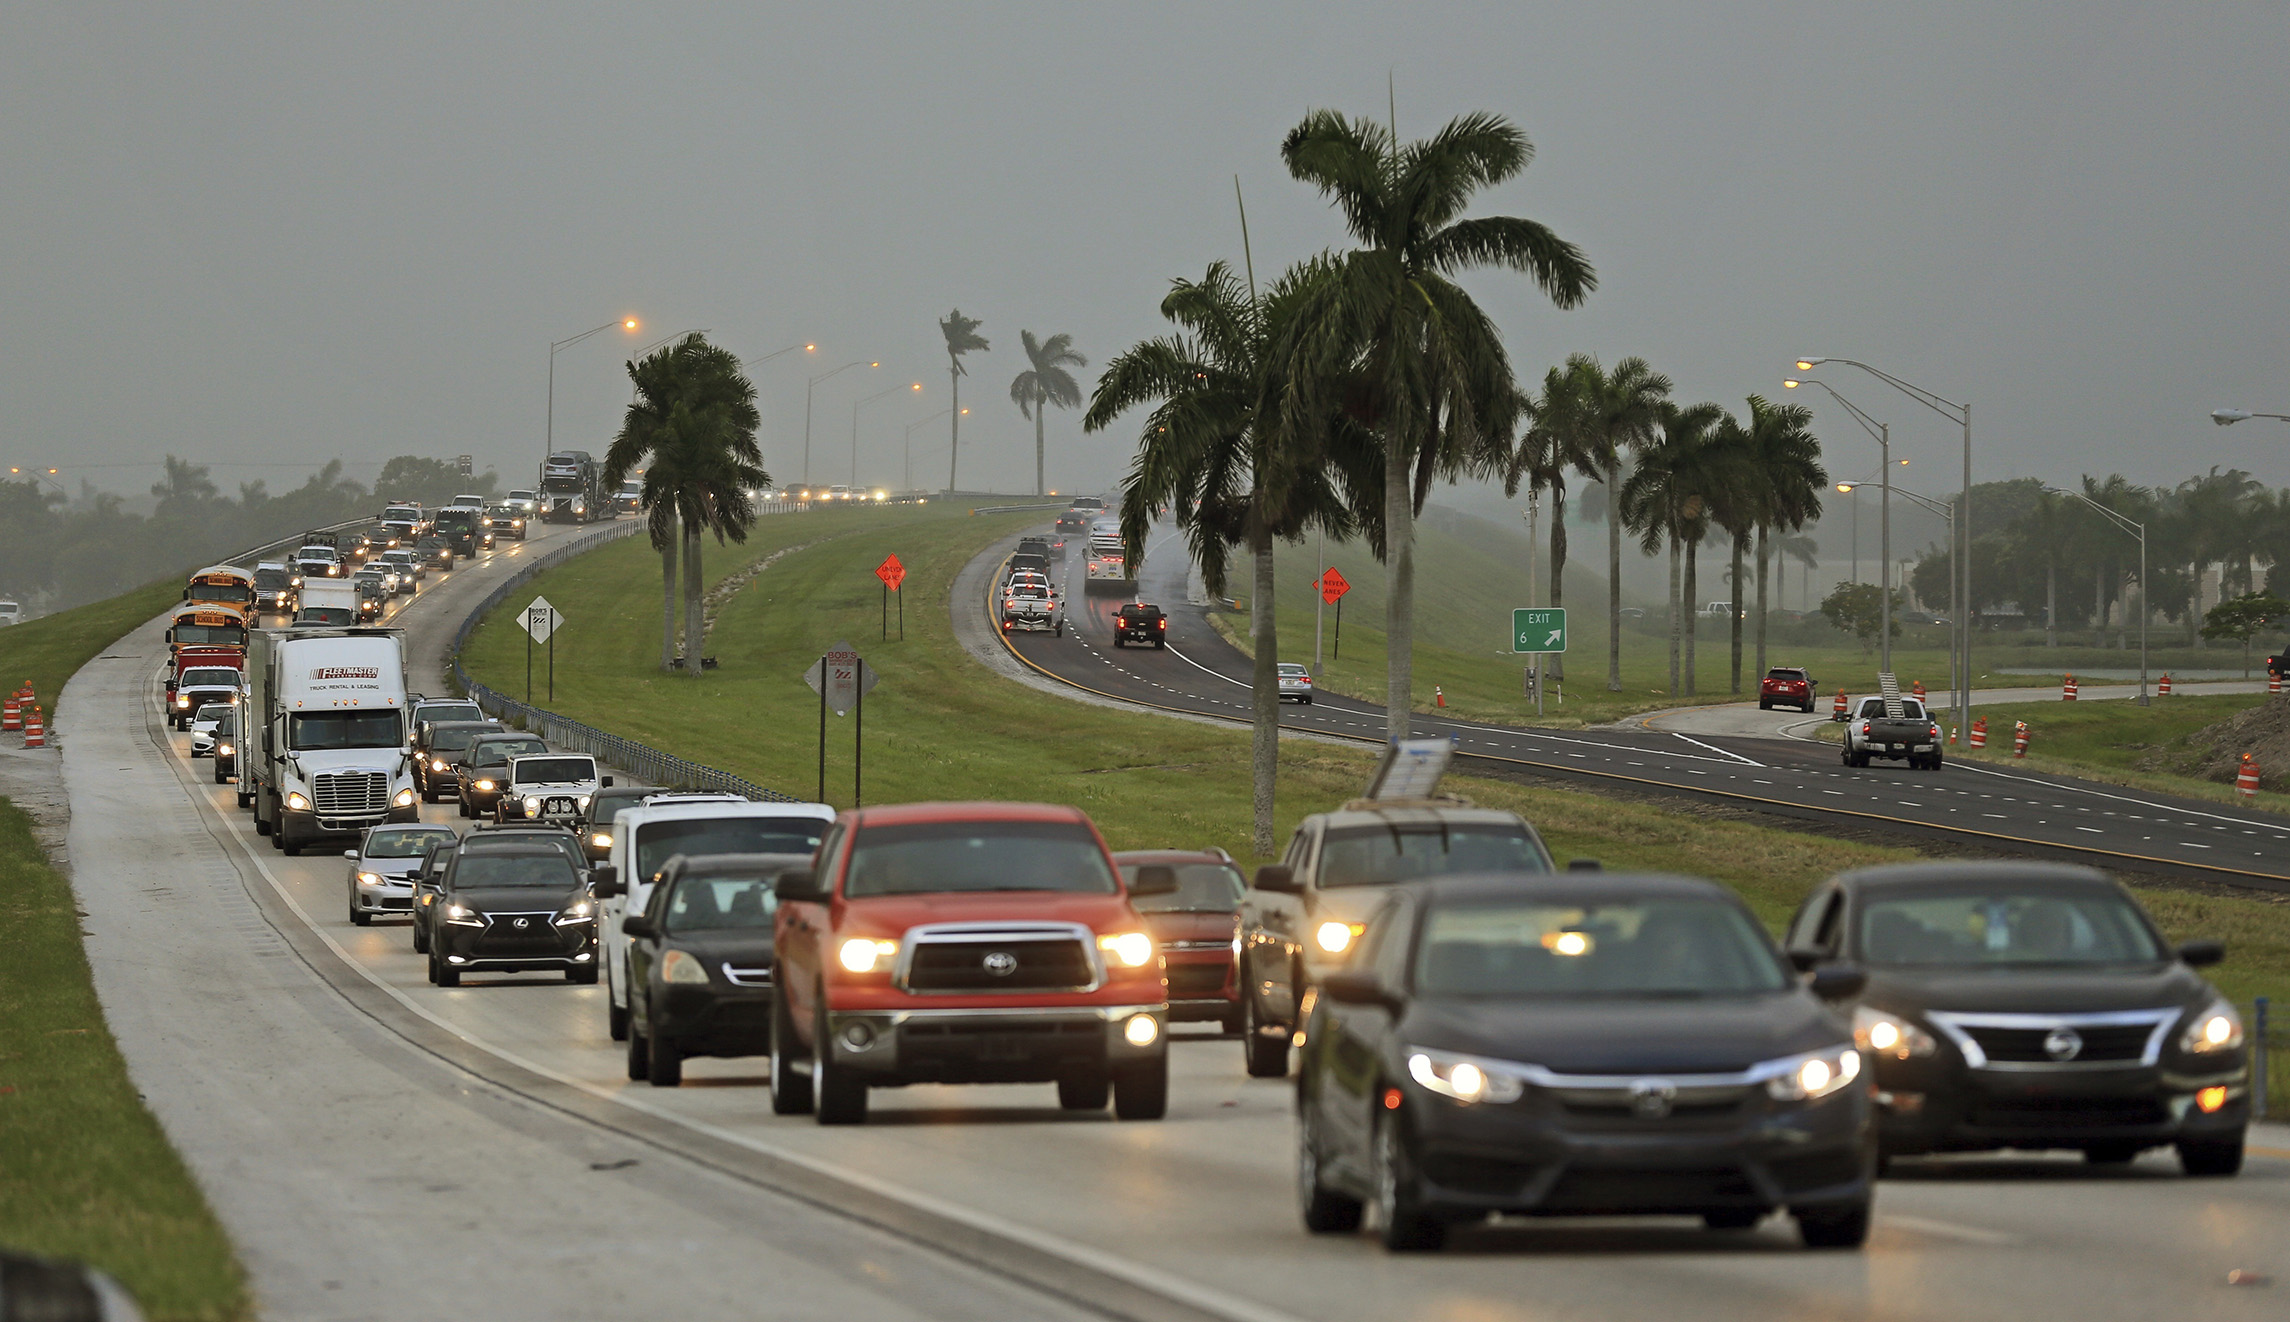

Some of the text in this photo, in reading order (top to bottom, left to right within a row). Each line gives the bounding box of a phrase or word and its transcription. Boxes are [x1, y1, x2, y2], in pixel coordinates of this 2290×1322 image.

[196, 615, 223, 624] SCHOOL BUS
[1528, 613, 1550, 624] EXIT
[1520, 631, 1527, 644] 6
[828, 651, 857, 659] BOB'S
[323, 667, 377, 678] FLEETMASTER
